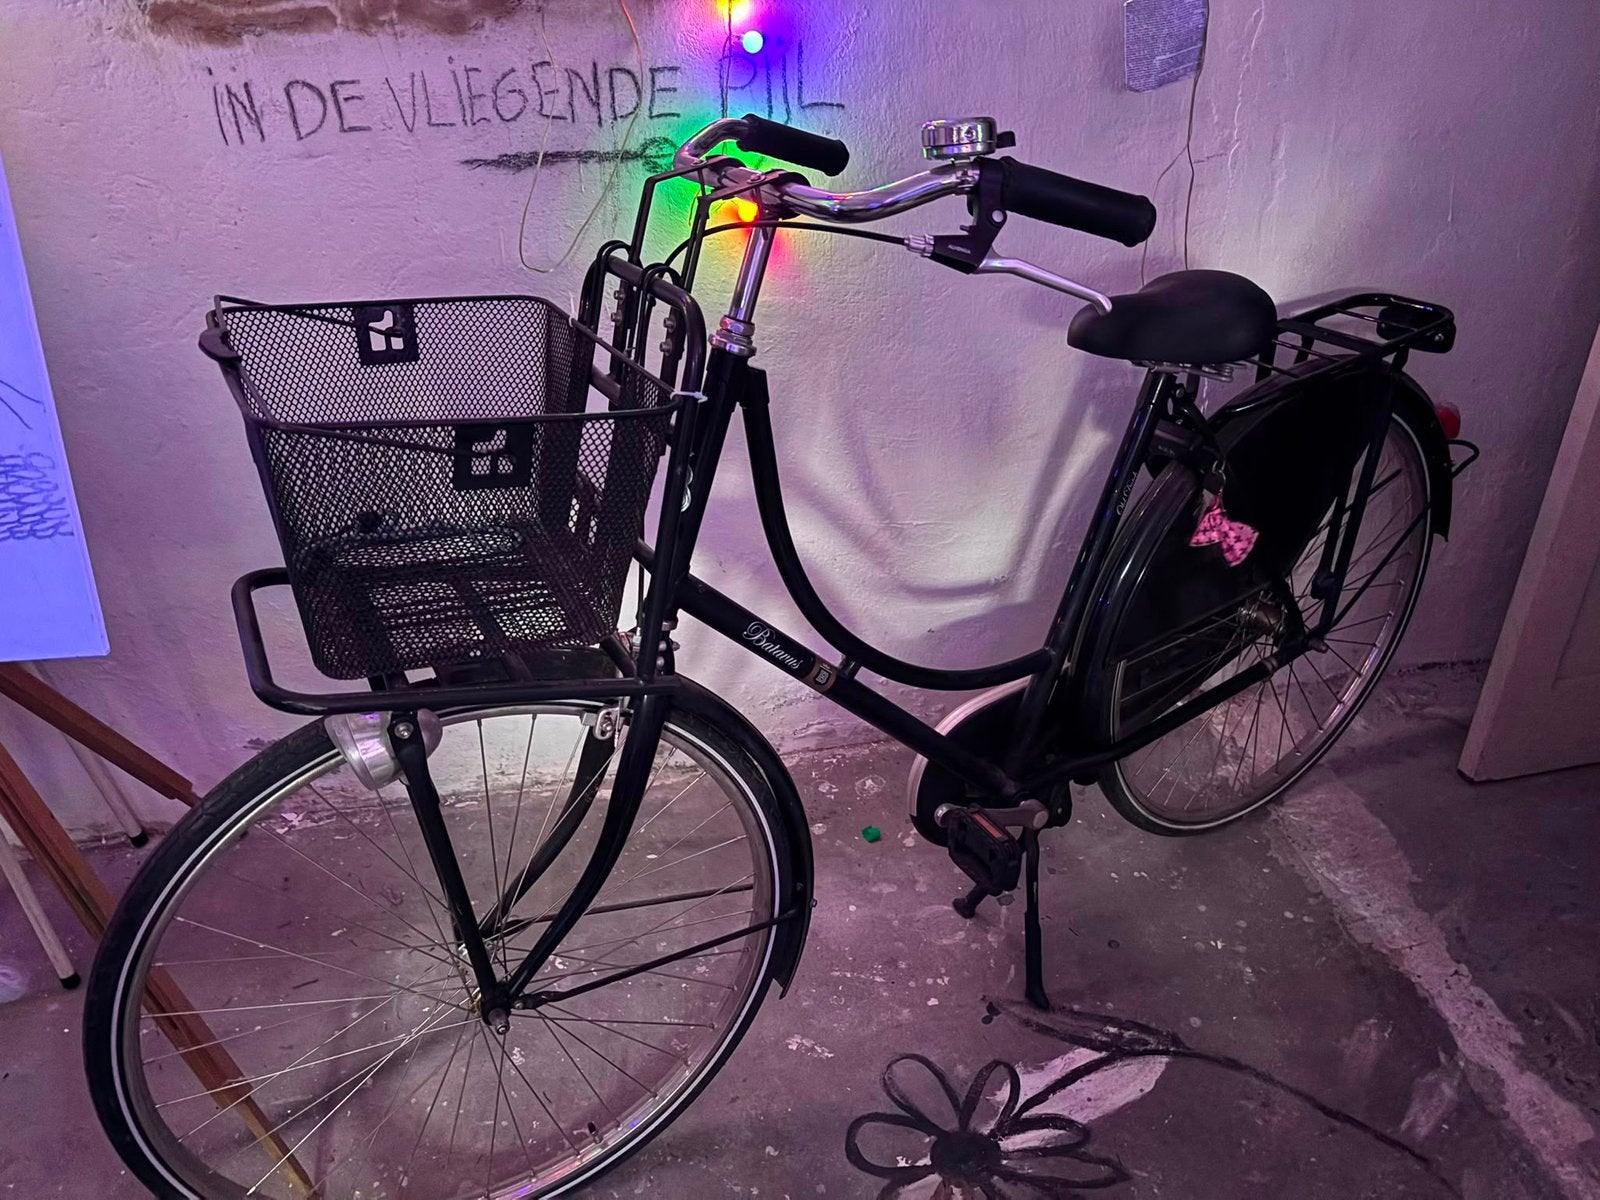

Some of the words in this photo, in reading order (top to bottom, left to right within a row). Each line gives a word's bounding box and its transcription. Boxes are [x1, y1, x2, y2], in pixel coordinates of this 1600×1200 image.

[284, 79, 372, 141] DE
[386, 56, 681, 132] VLIEGENDE
[742, 621, 804, 670] Batavus
